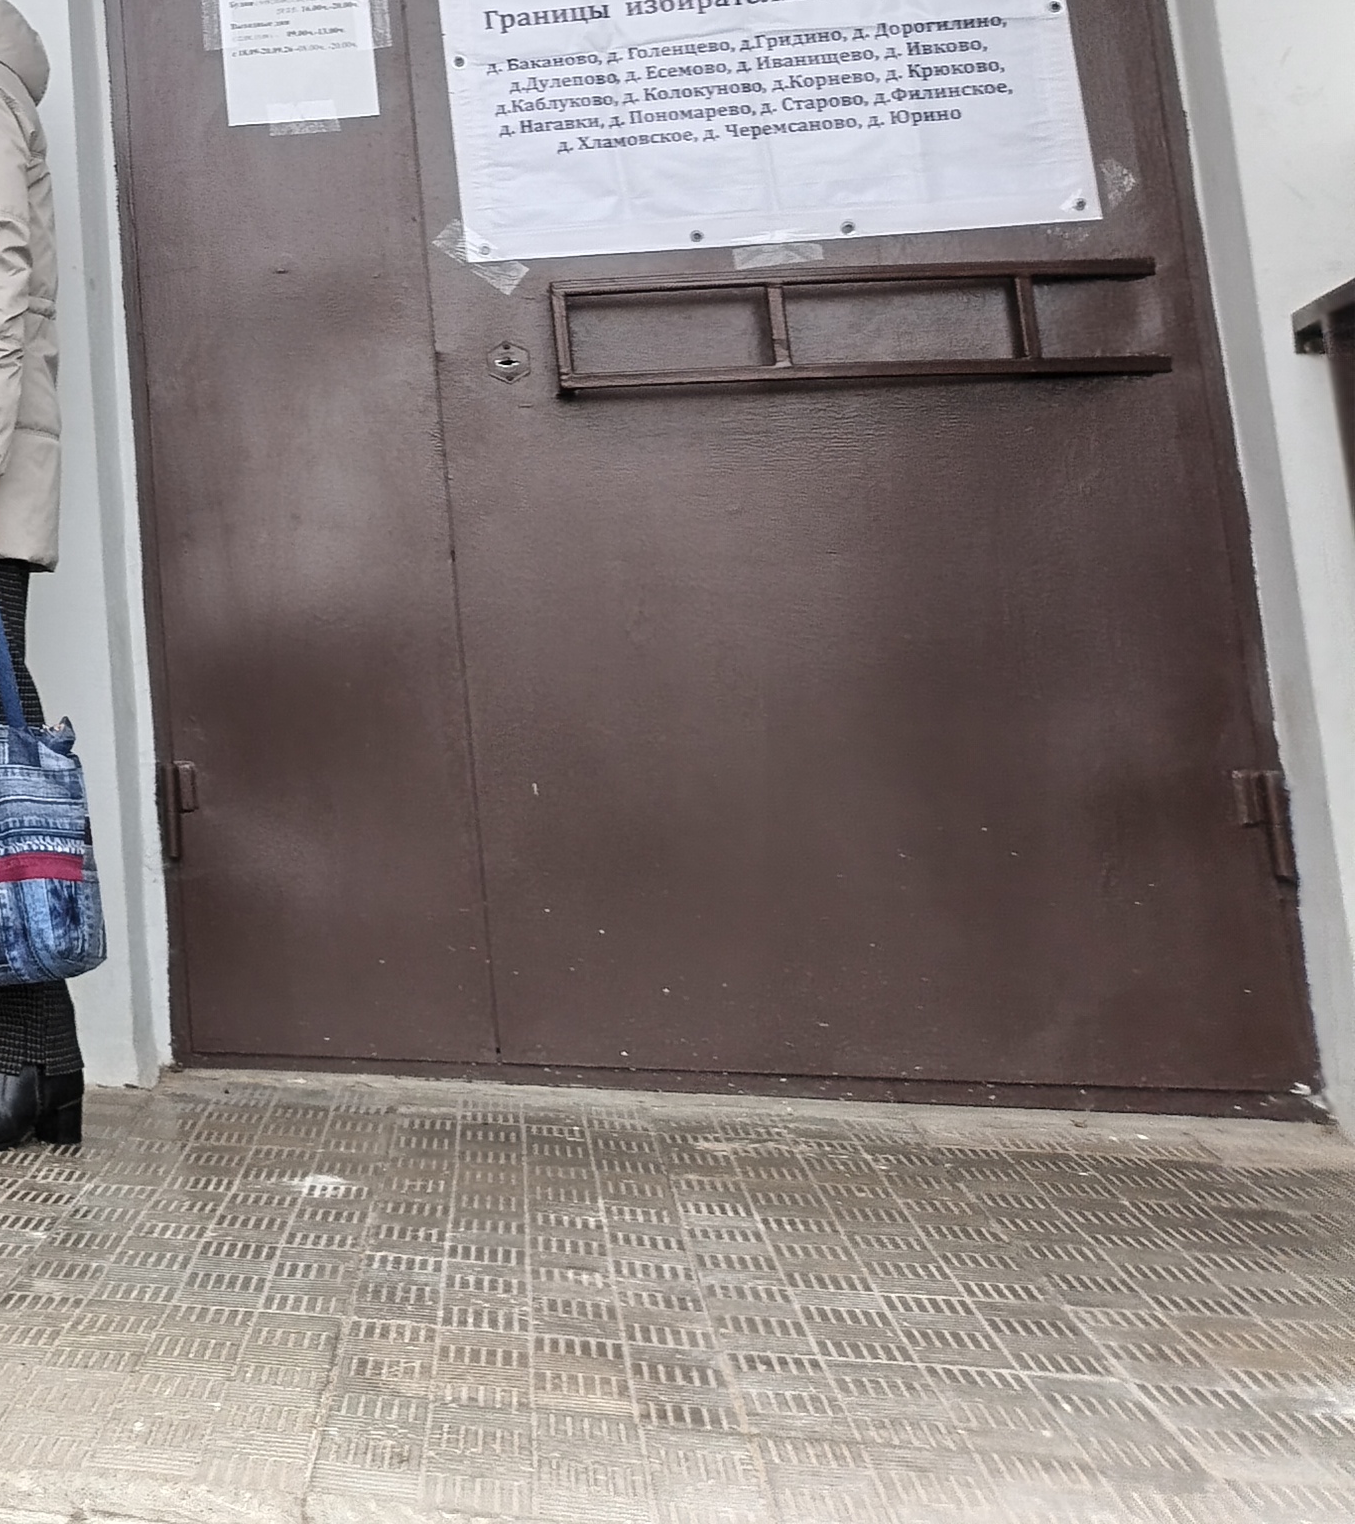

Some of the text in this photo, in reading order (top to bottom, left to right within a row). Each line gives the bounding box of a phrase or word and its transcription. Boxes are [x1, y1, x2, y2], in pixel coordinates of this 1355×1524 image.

[484, 4, 611, 33] Границы
[487, 63, 503, 75] д.
[506, 53, 603, 71] Баканово,
[607, 51, 623, 64] д.
[628, 40, 736, 60] Голенцево,
[852, 28, 871, 41] д.
[874, 15, 1007, 39] Дорогилино,
[625, 70, 641, 83] д.
[646, 62, 732, 80] Есемово,
[736, 61, 752, 73] д.
[757, 49, 880, 69] Иванищево,
[884, 47, 902, 59] д.
[907, 39, 988, 56] Ивково,
[622, 92, 639, 106] д.
[644, 80, 767, 101] Колокуново,
[885, 69, 903, 82] д.
[907, 60, 1005, 80] Крюково,
[499, 124, 516, 137] д.
[519, 114, 605, 134] Нагавки,
[608, 114, 625, 128] д.
[629, 103, 756, 124] Пономарево,
[760, 102, 777, 114] д.
[782, 94, 868, 113] Старово,
[557, 107, 962, 154] д. Хламовское, д. Черемсаново, д. Юрино
